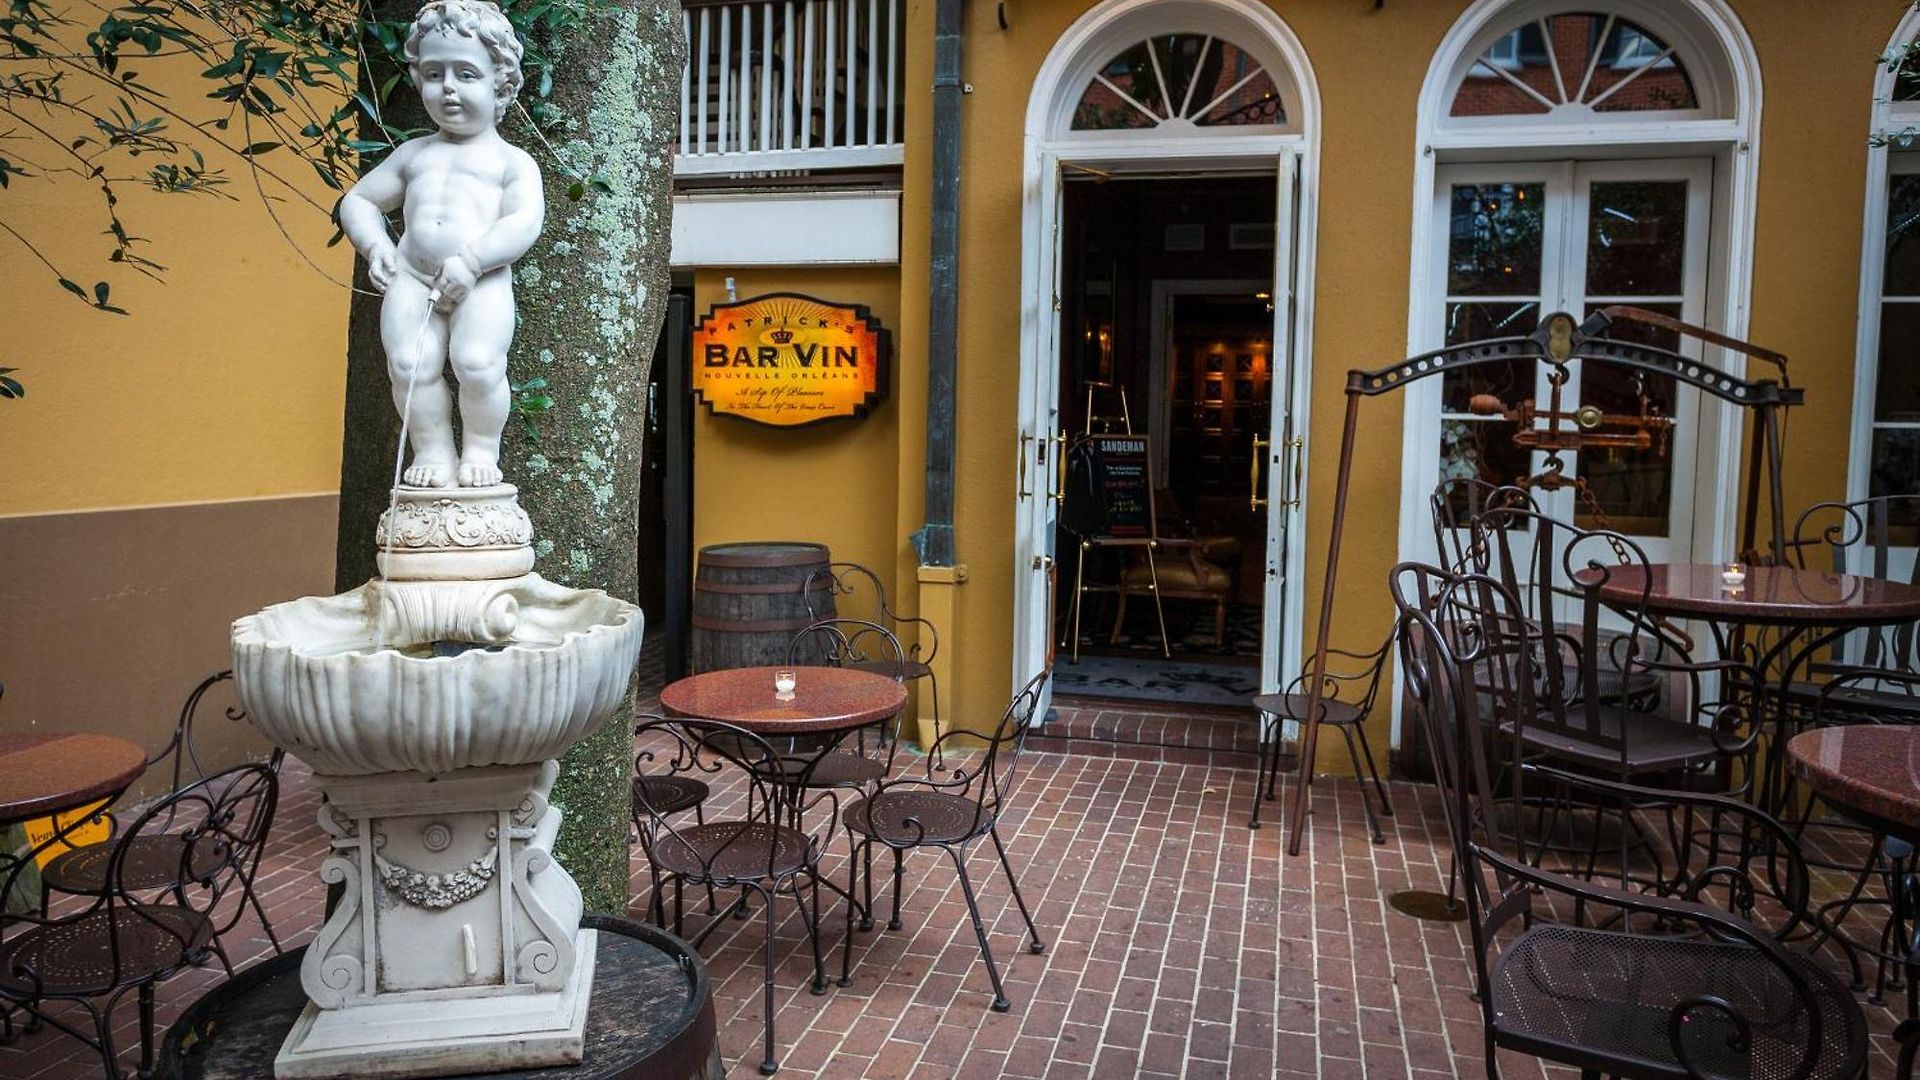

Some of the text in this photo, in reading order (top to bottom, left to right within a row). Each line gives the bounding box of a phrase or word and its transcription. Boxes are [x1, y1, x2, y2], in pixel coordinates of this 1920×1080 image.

[708, 314, 855, 336] PATRICK'S
[704, 343, 858, 368] BAR VIN
[704, 372, 780, 380] NOUVELLE
[1101, 440, 1145, 452] SANDEMAN
